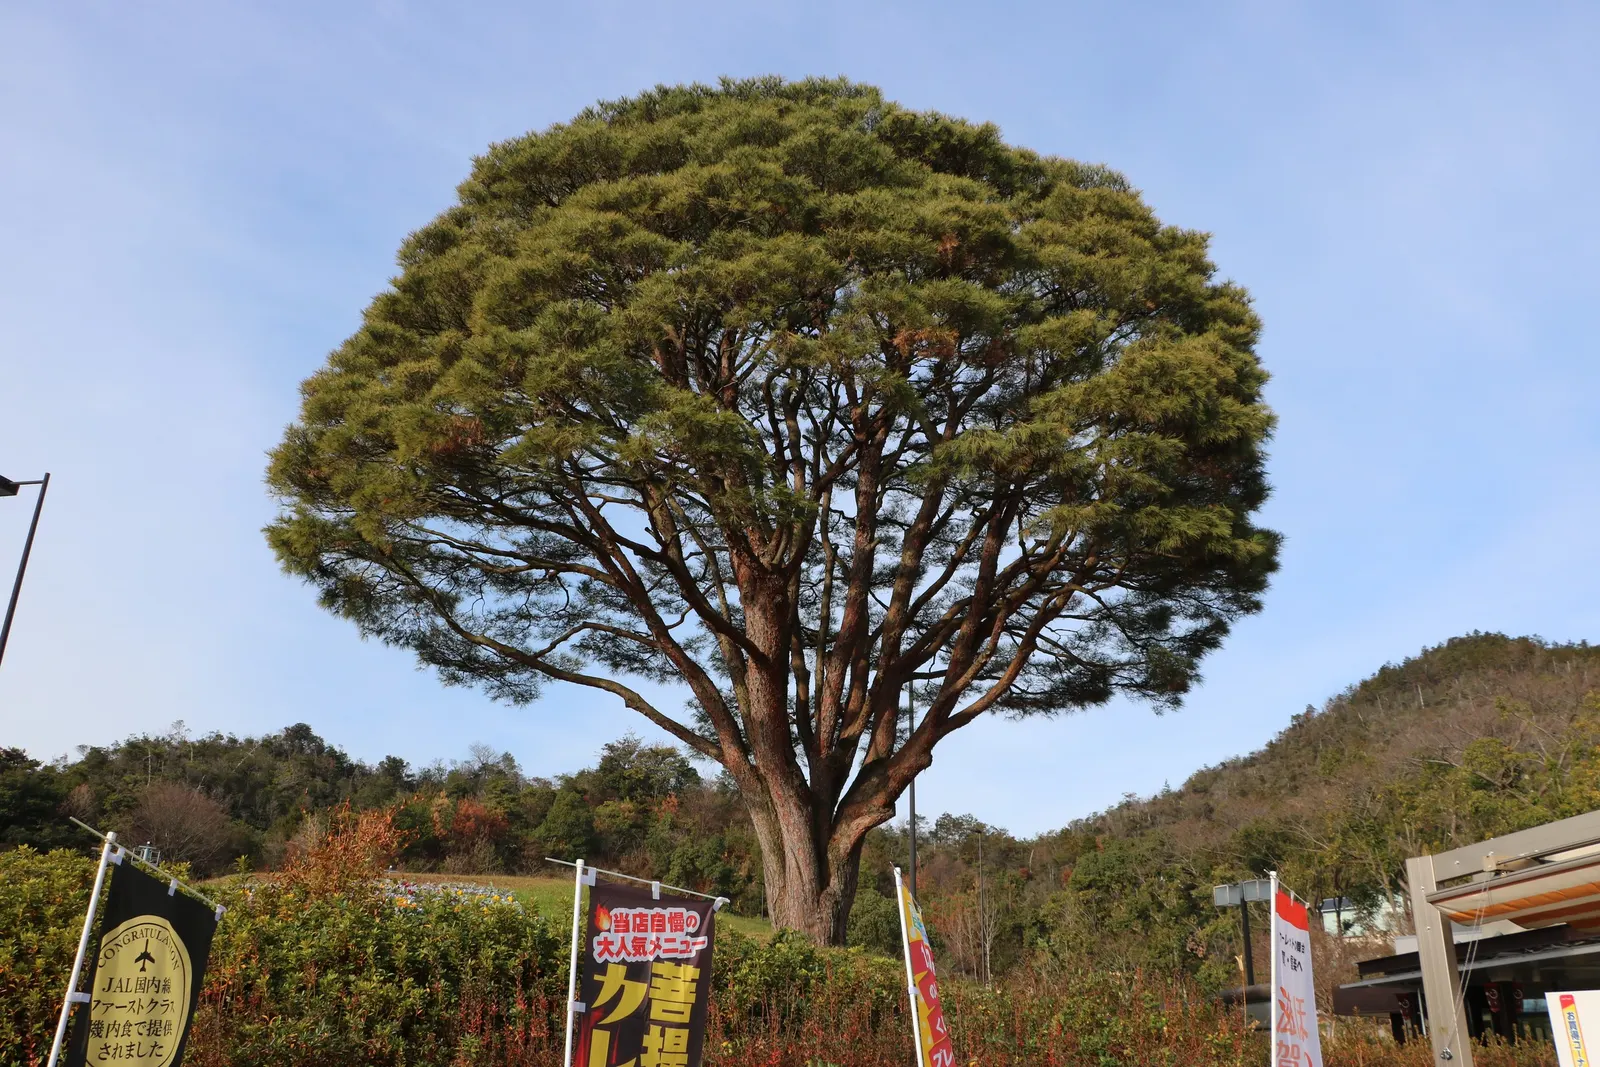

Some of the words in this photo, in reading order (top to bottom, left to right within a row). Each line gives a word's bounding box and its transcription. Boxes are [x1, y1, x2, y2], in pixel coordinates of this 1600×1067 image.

[613, 911, 698, 934] 当店自慢の
[597, 936, 706, 957] 大人気メニュー
[91, 998, 175, 1016] ファーストクラス
[90, 1019, 173, 1039] 機内食で提供
[98, 1041, 164, 1061] されました
